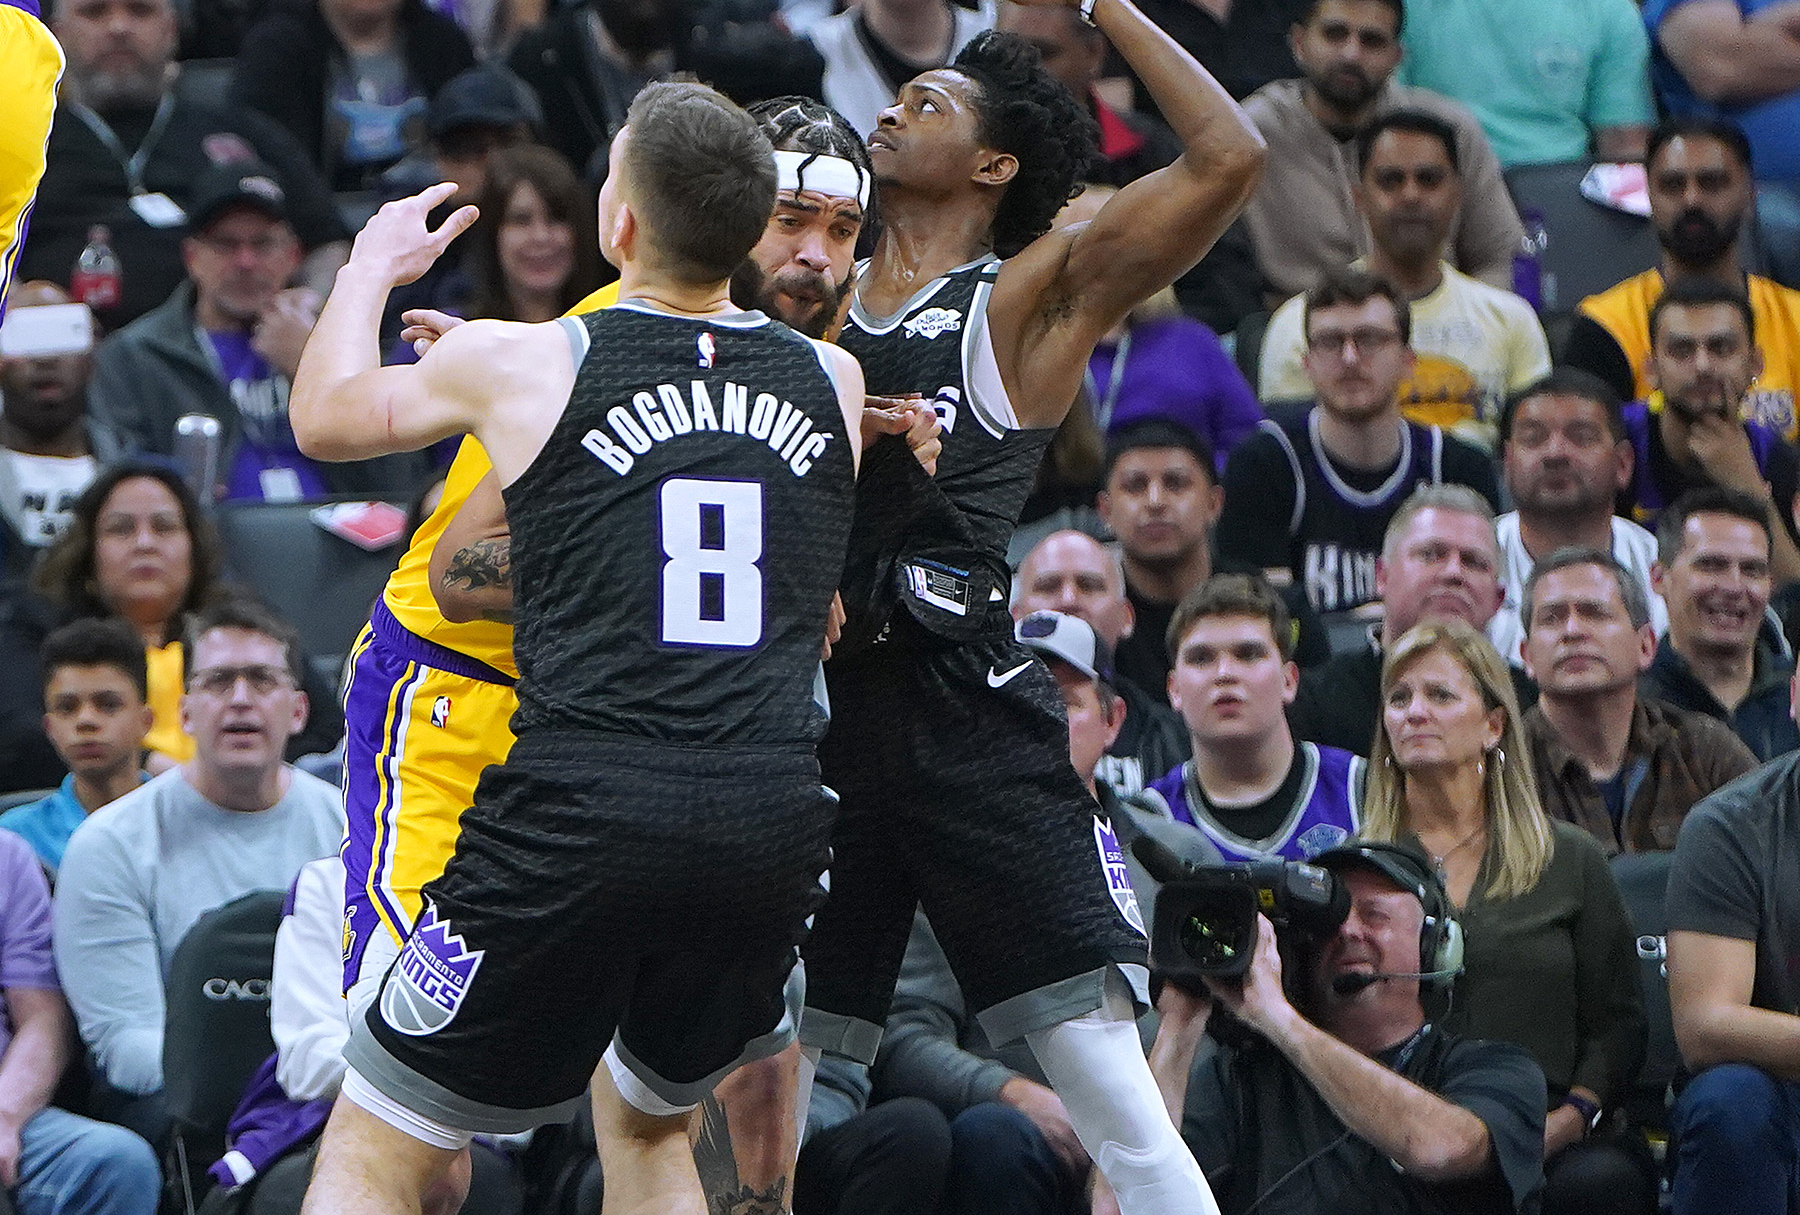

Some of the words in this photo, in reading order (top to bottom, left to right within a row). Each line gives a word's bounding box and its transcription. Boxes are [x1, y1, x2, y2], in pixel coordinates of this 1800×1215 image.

[580, 379, 835, 478] BOGDANOVIĆ
[659, 477, 765, 648] 8
[1304, 543, 1377, 610] KIN
[202, 977, 272, 1002] CAC
